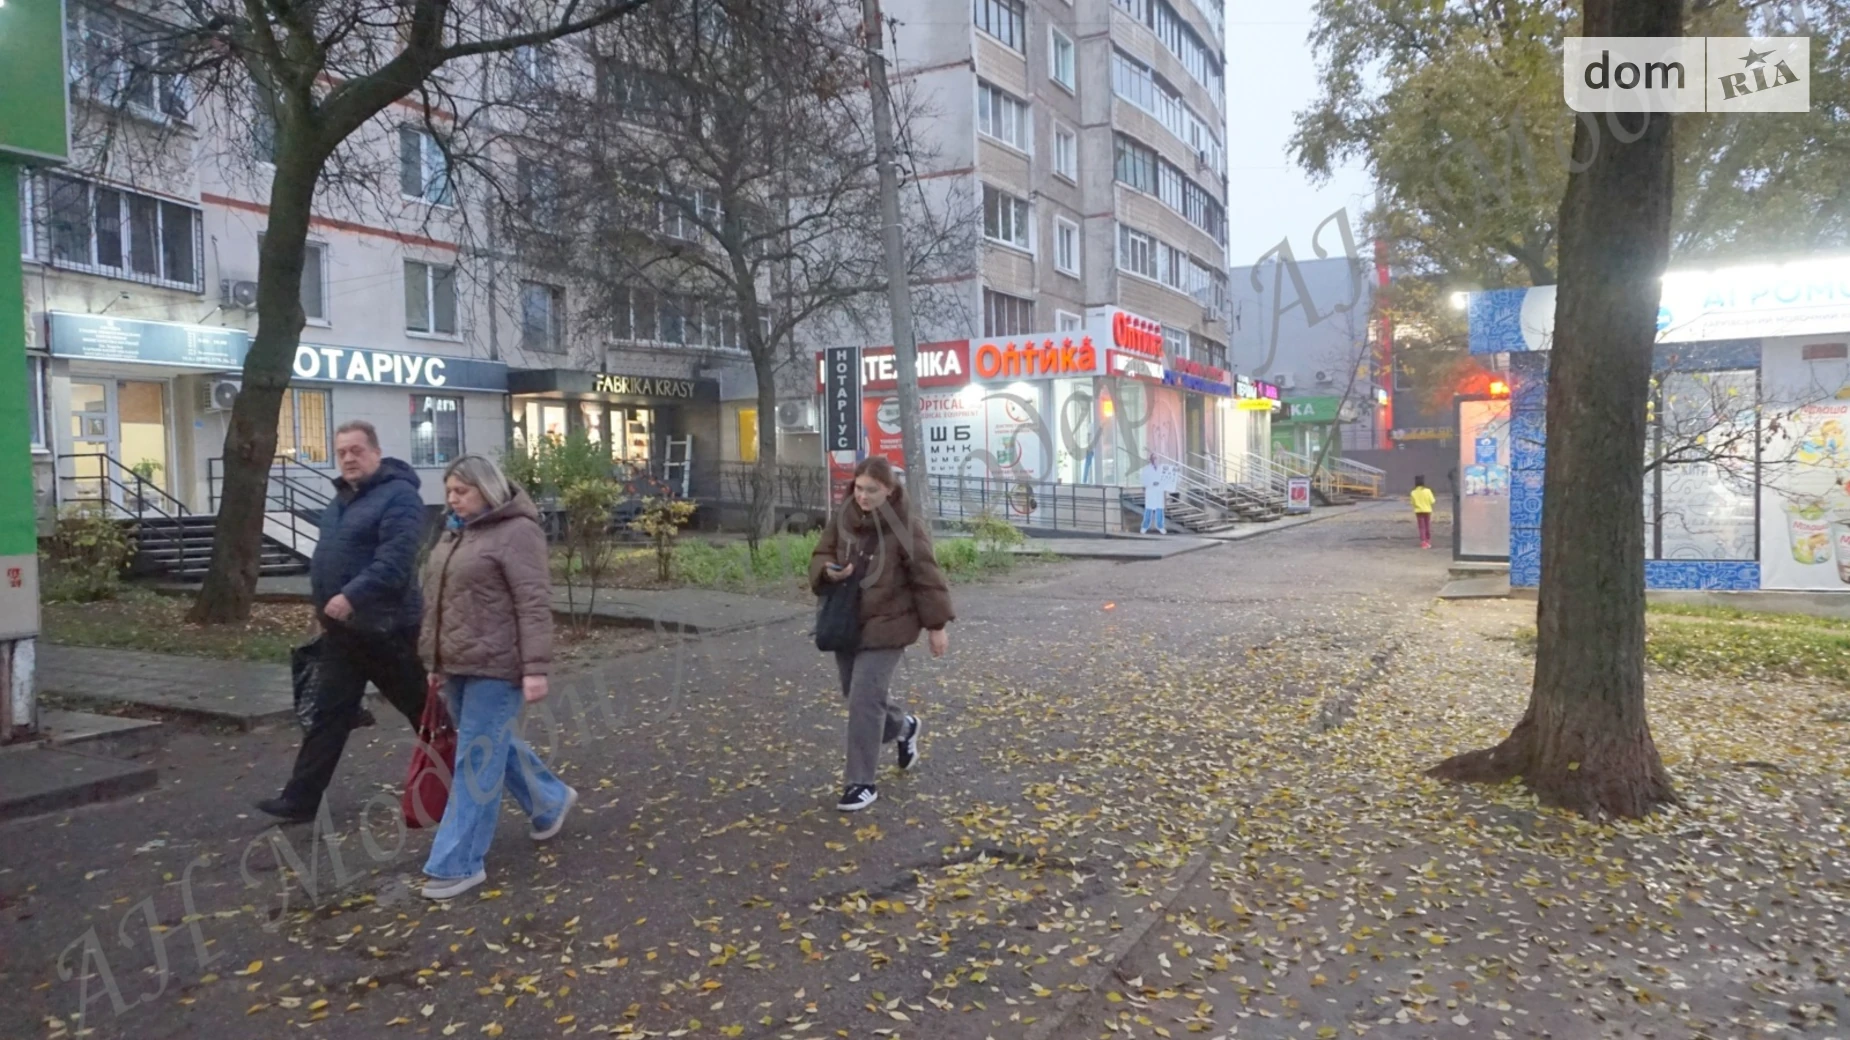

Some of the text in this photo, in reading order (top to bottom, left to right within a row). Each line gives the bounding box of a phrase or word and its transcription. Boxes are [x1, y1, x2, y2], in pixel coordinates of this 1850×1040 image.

[293, 346, 446, 387] ОТАРІУС
[820, 350, 962, 385] ТЕНІКА
[975, 342, 1097, 378] Оптика
[596, 374, 696, 398] FABRIKA KRASY
[836, 350, 848, 448] НОТАРІУС
[930, 424, 971, 442] Ш Б
